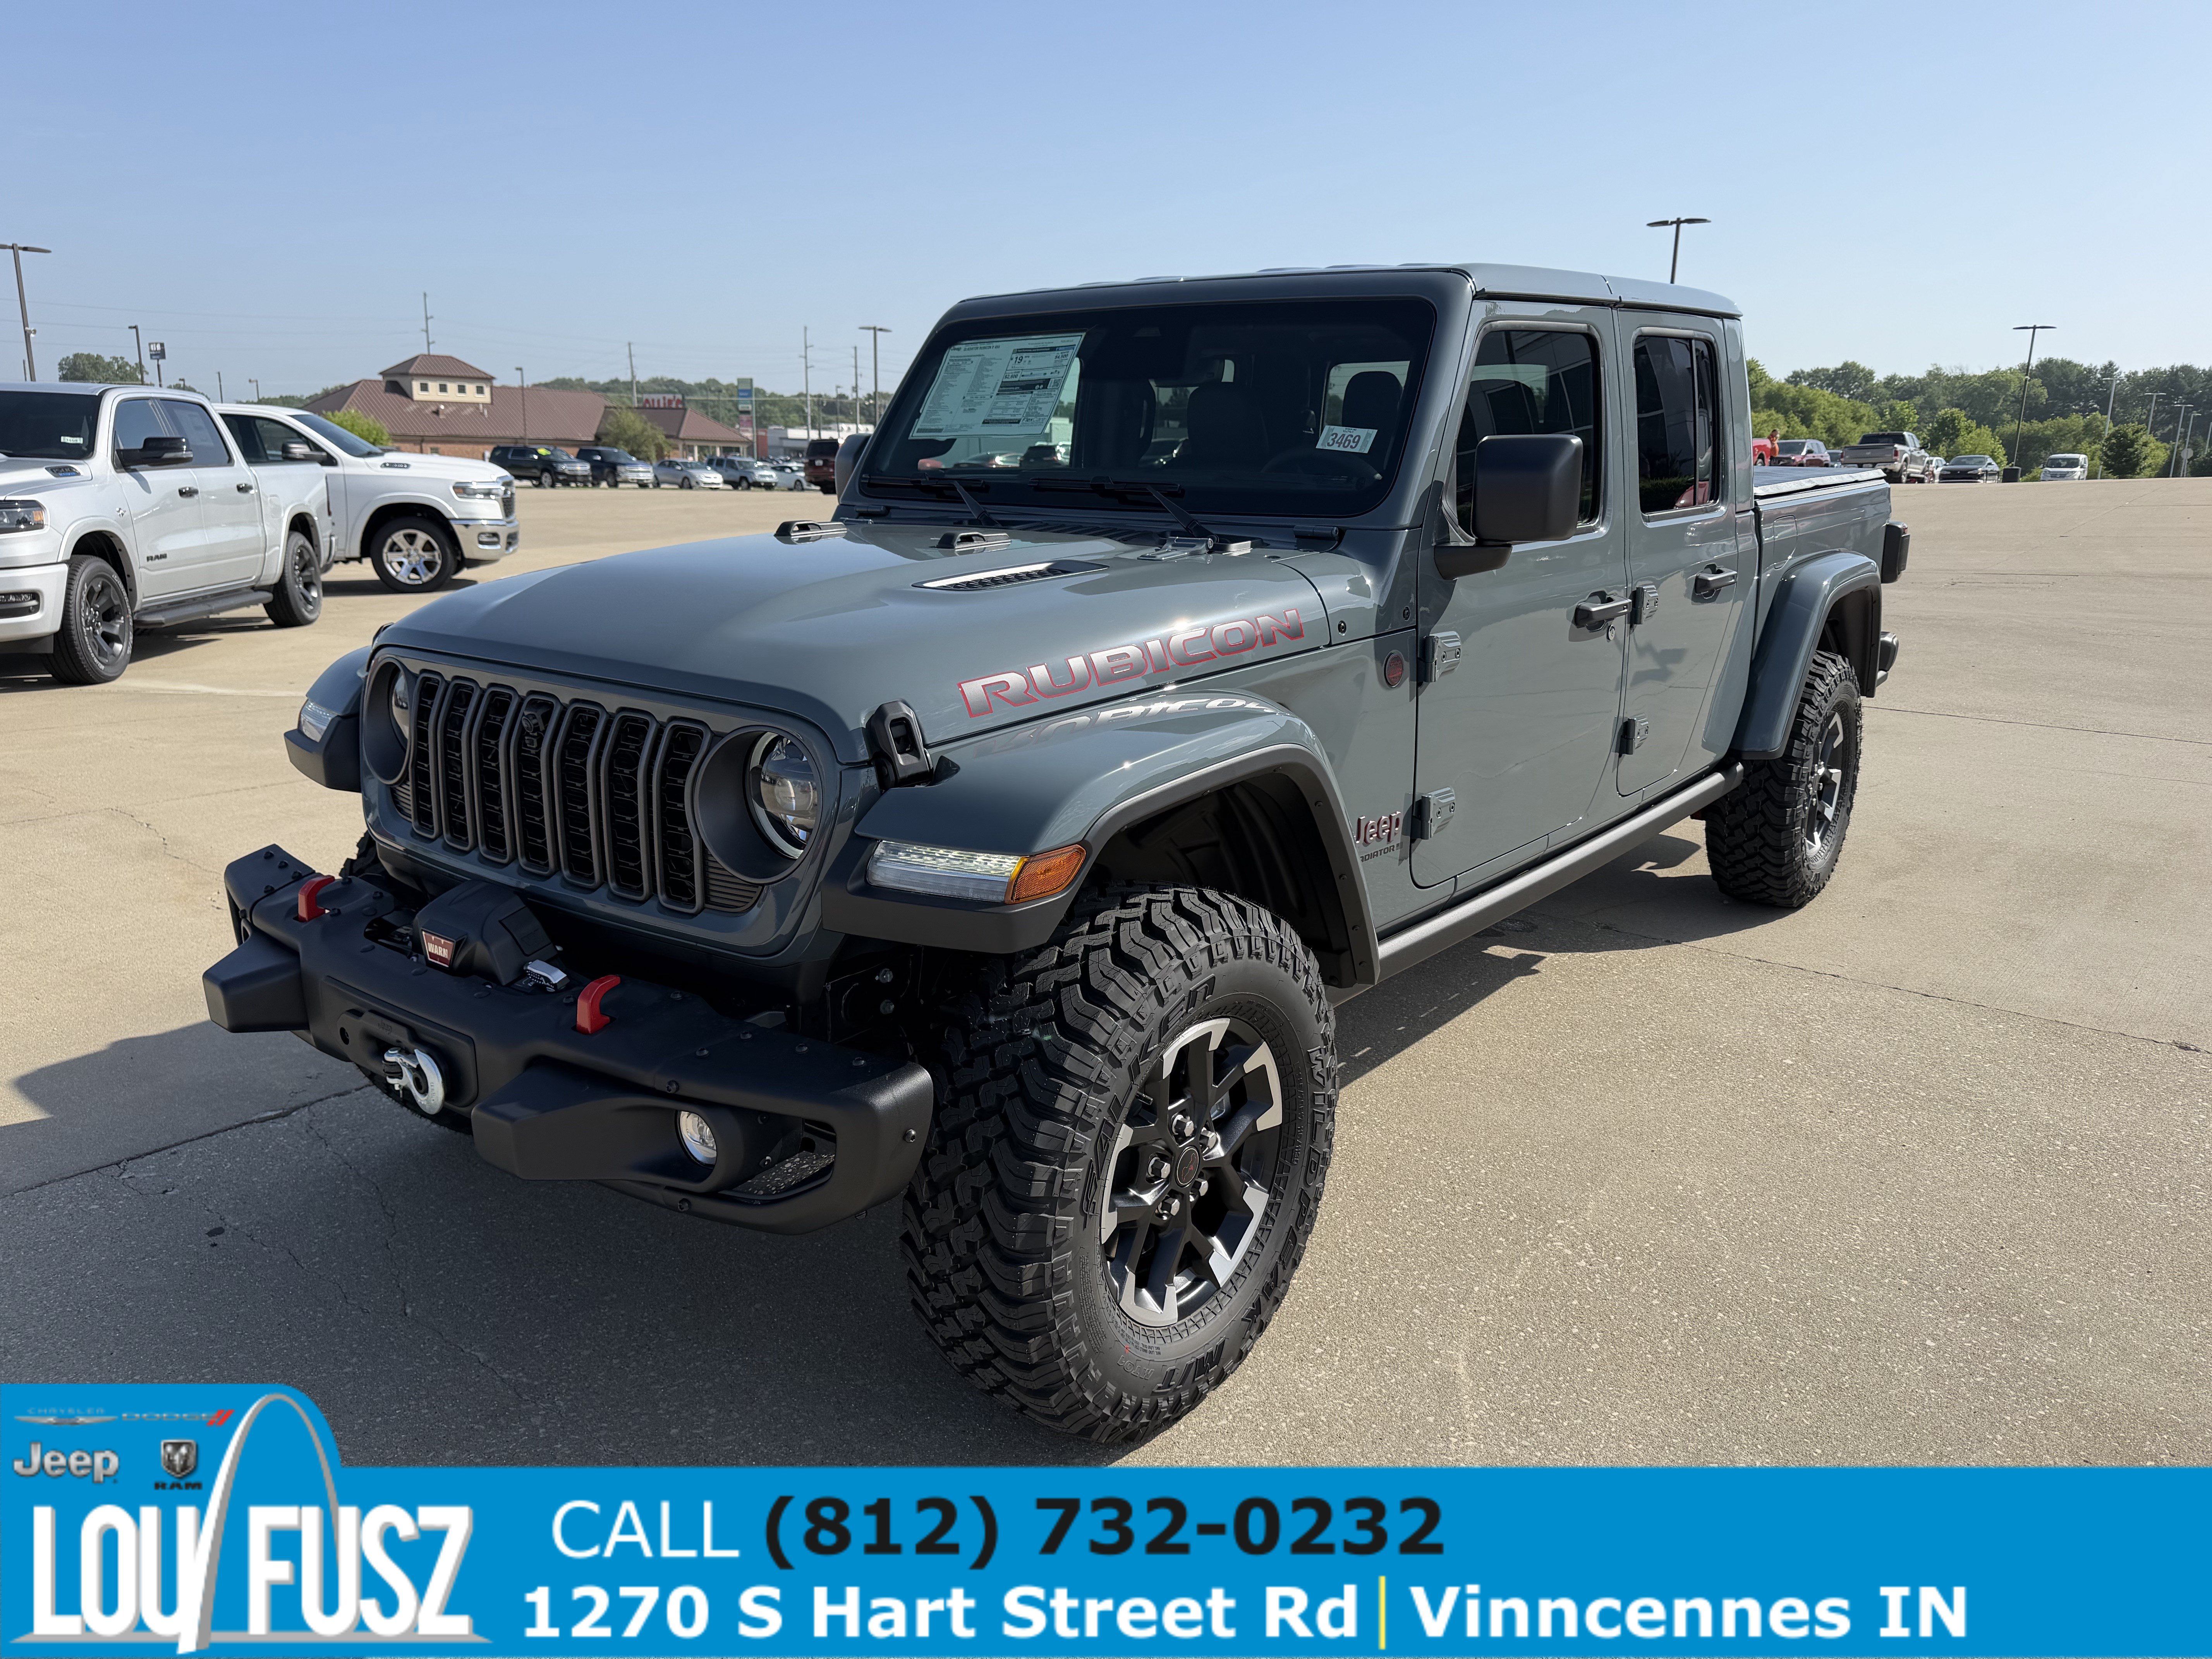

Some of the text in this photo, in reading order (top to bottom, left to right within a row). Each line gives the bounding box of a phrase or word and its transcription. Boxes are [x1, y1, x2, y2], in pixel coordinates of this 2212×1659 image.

[1327, 433, 1361, 449] 3469
[957, 608, 1305, 718] RUBICON
[1355, 811, 1401, 843] Jeep
[1360, 845, 1395, 862] ADIATOR
[428, 942, 448, 958] WARN
[1117, 1355, 1155, 1380] MT01
